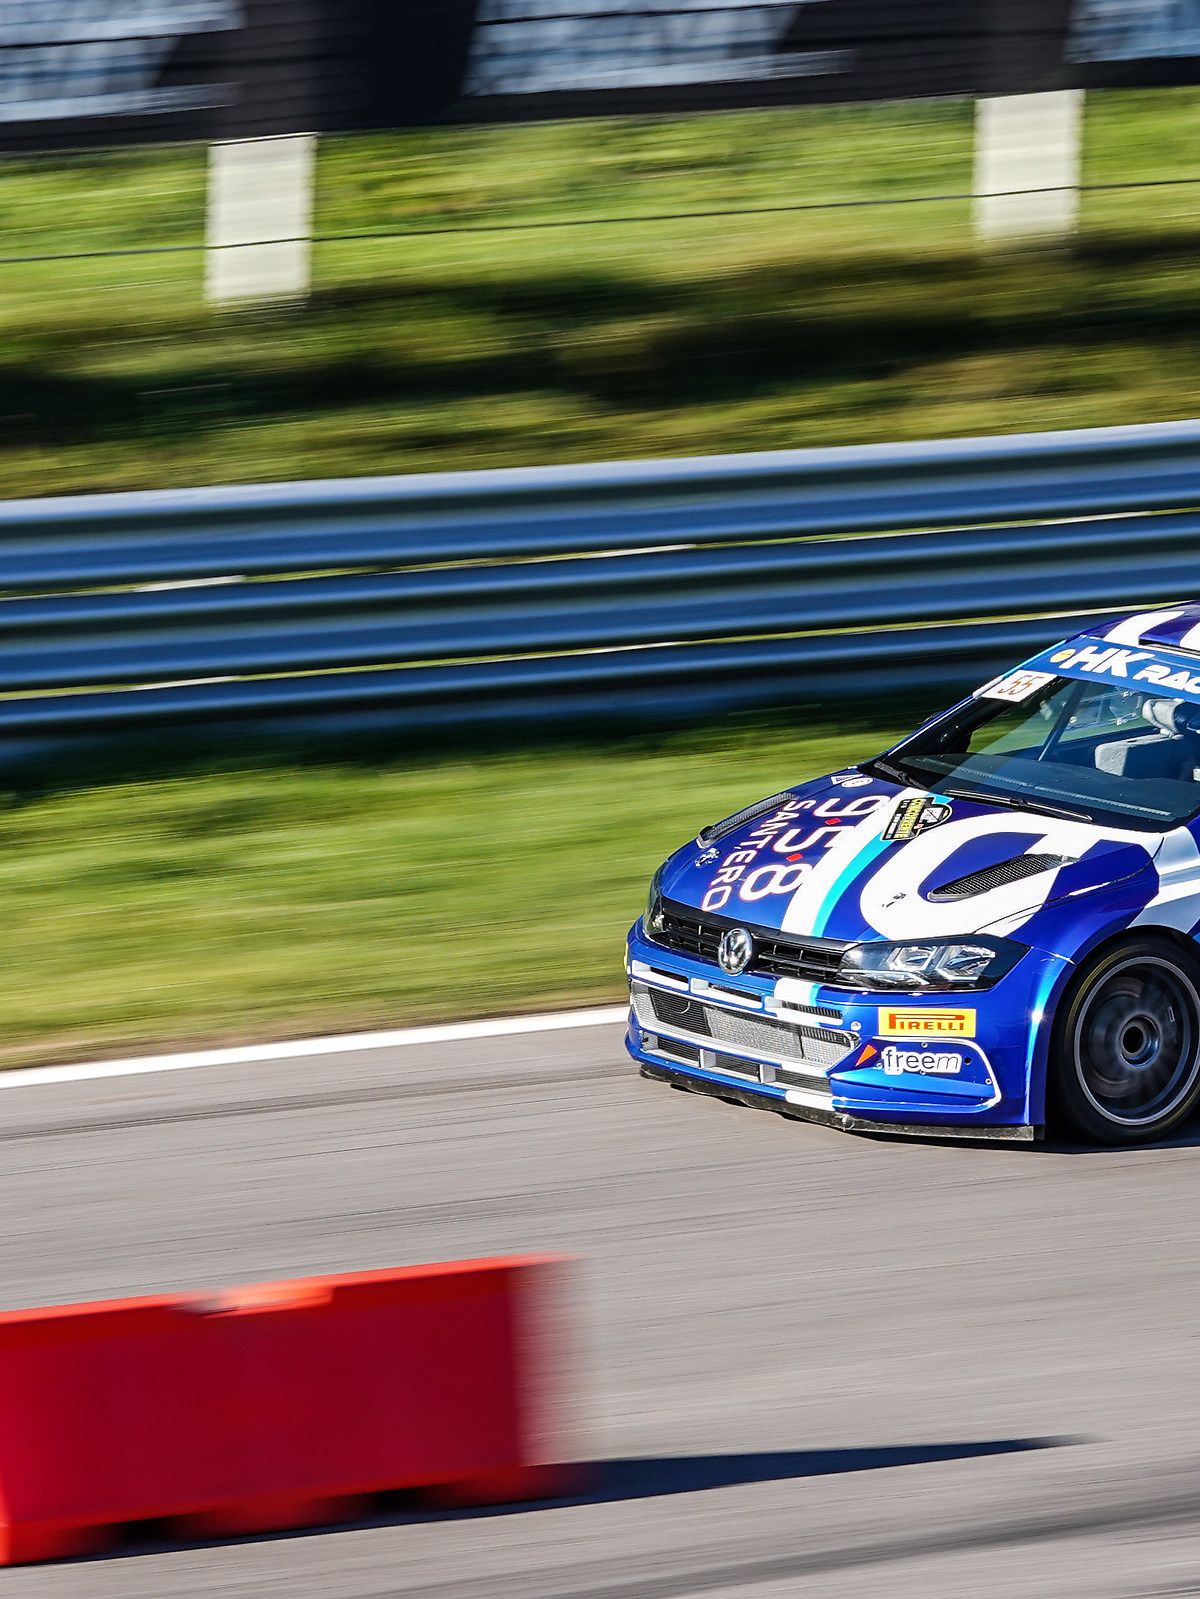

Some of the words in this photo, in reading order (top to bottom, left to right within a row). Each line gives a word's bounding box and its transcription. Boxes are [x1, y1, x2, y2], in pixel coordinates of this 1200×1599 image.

[1058, 645, 1156, 678] HK
[700, 799, 818, 912] SANTERO
[888, 1013, 966, 1031] PIRELLI
[885, 1049, 960, 1070] freem
